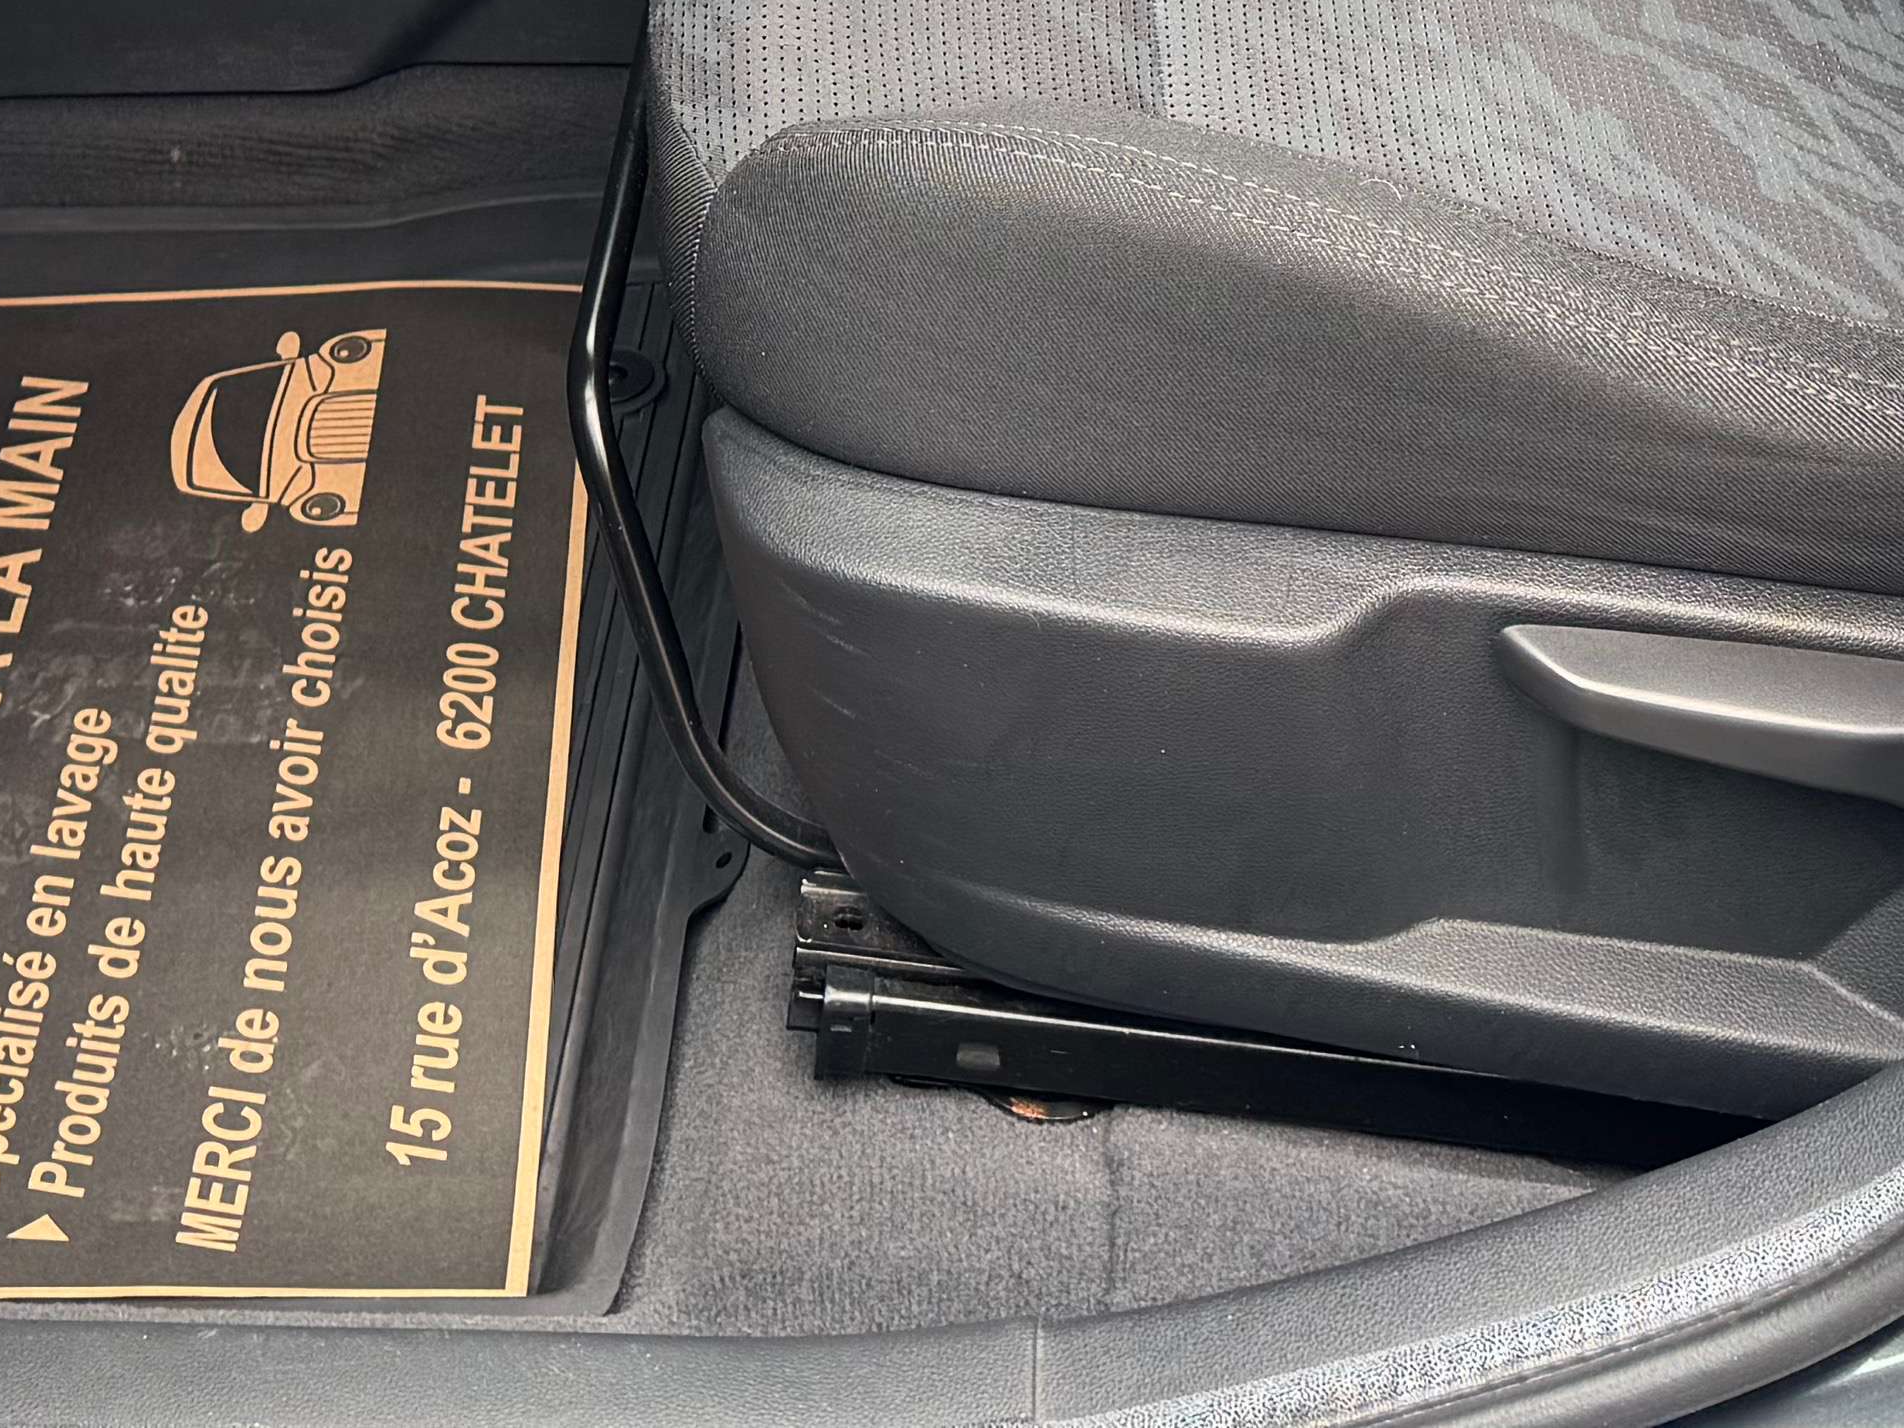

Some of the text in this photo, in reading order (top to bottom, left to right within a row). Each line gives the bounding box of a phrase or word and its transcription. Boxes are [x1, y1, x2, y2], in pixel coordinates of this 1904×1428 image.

[450, 393, 526, 632] CHATELET
[434, 642, 501, 752] 6200
[29, 707, 119, 860] lavage
[26, 873, 76, 937] en
[28, 605, 209, 1199] Produits de haute qualite
[175, 546, 354, 1253] MERCI de nous avoir choisis
[410, 1000, 465, 1094] rue
[385, 1102, 454, 1167] 15
